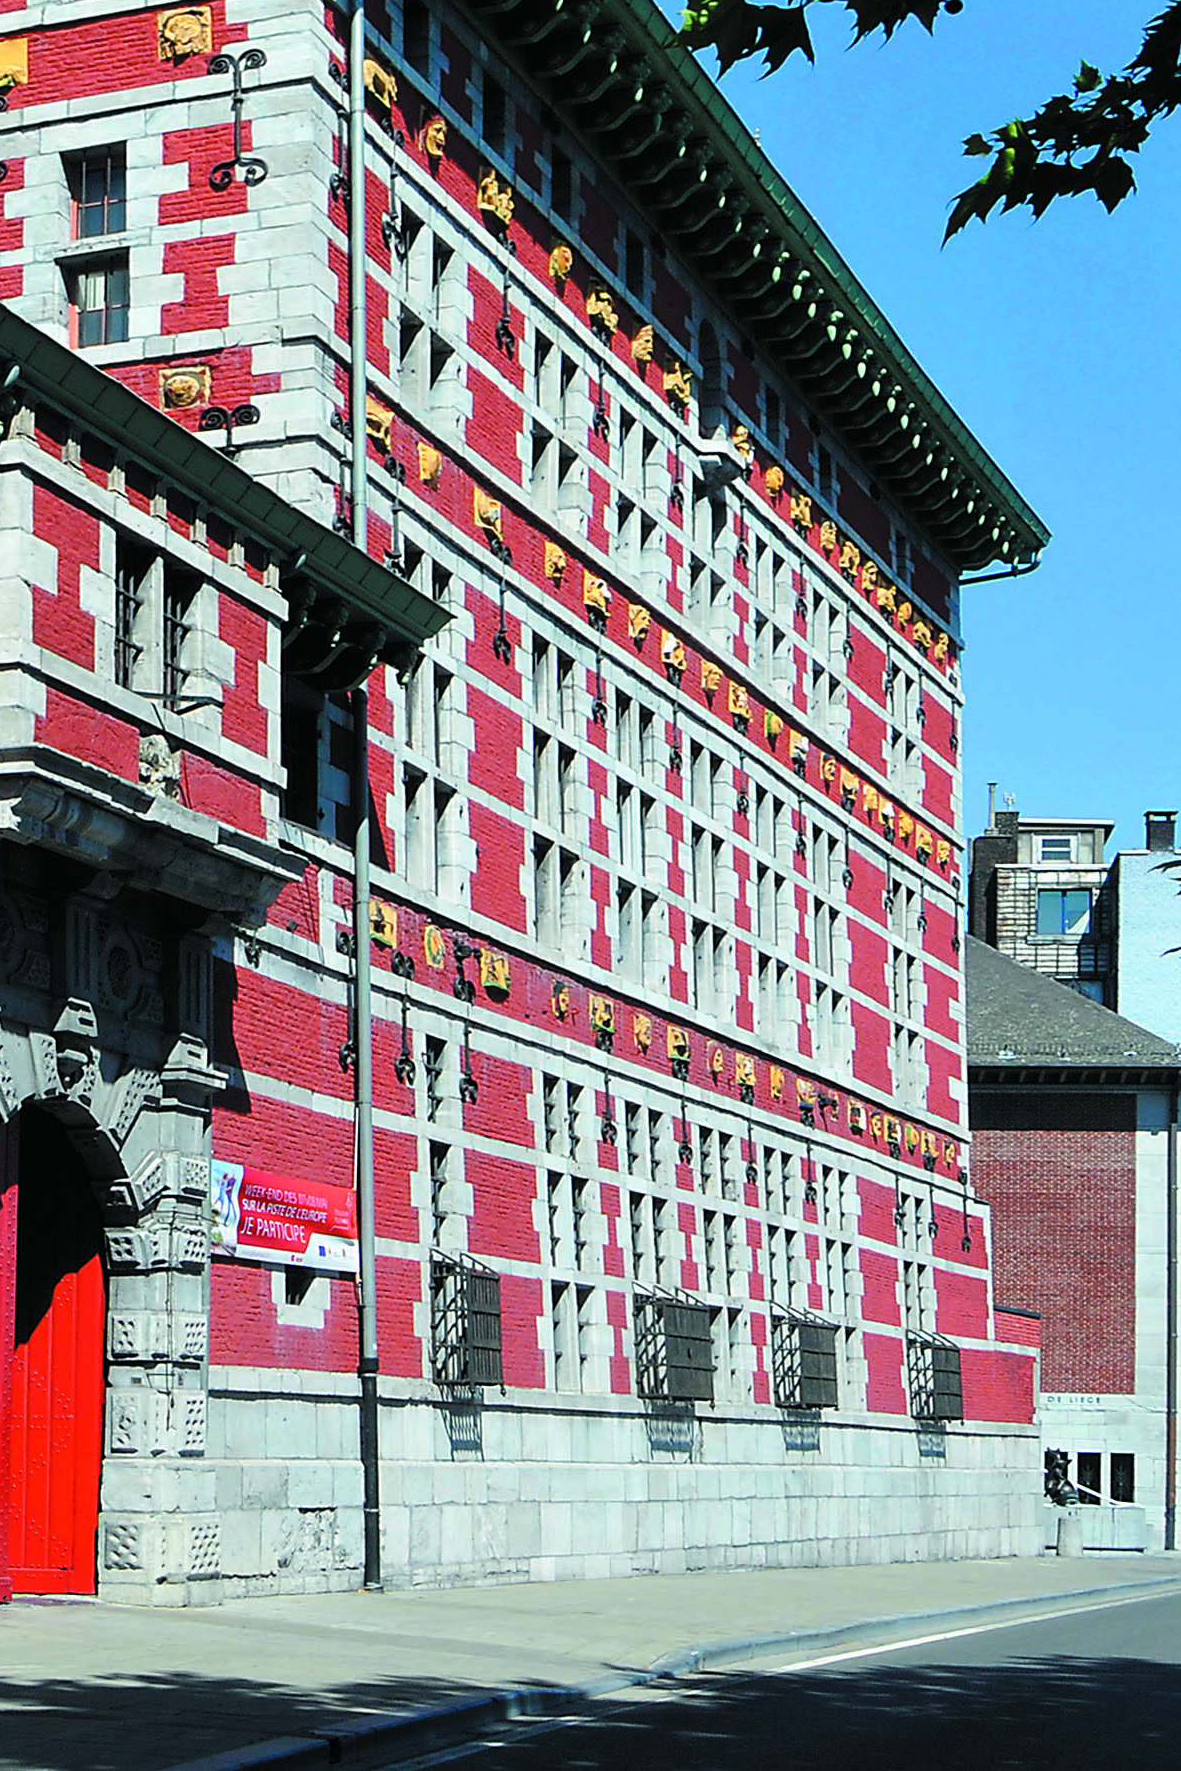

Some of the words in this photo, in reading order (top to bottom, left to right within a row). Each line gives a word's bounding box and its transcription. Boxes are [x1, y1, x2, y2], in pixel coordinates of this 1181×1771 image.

[244, 1184, 284, 1202] WEEK-END
[242, 1198, 256, 1212] SUR
[256, 1201, 266, 1213] LA
[266, 1203, 286, 1217] PISTE
[285, 1205, 297, 1219] DE
[240, 1216, 255, 1235] JE
[256, 1218, 308, 1244] PARTICIPE
